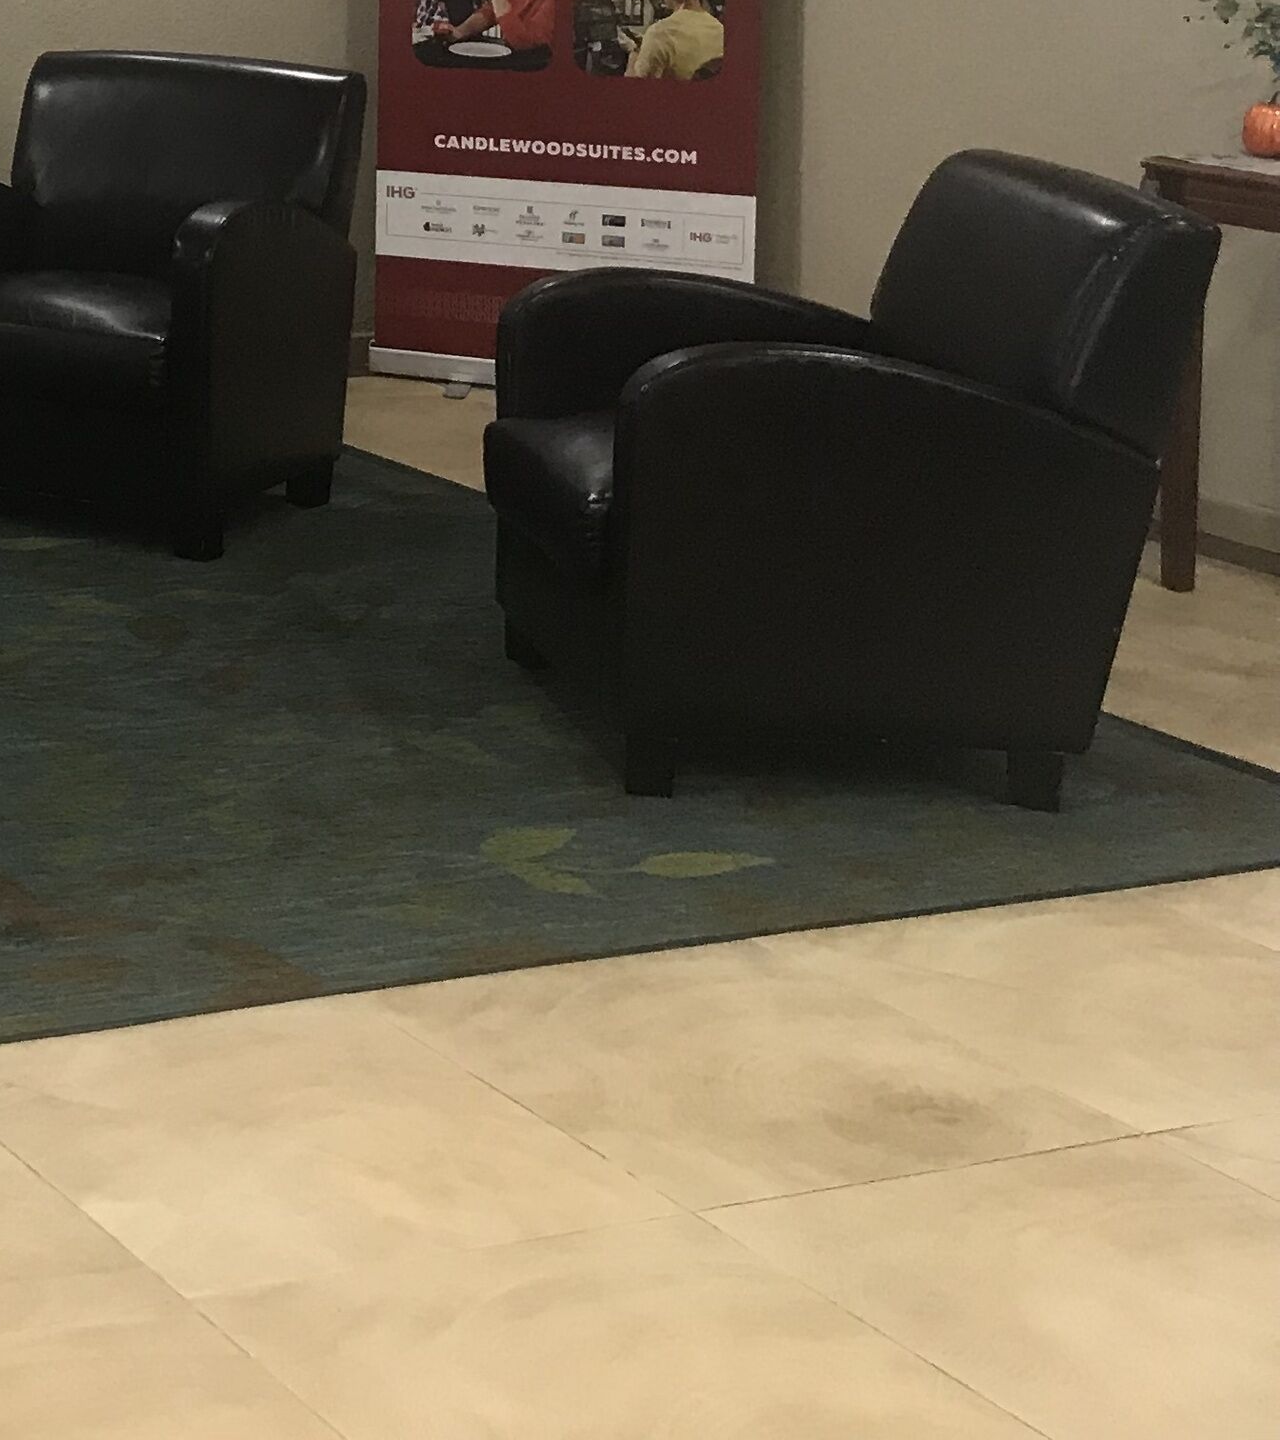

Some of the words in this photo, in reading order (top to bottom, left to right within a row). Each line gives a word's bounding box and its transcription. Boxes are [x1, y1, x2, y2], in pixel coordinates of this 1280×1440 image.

[434, 133, 698, 165] CANDLEWOODSUITES.COM
[386, 185, 416, 199] IHG
[689, 231, 713, 243] IHG
